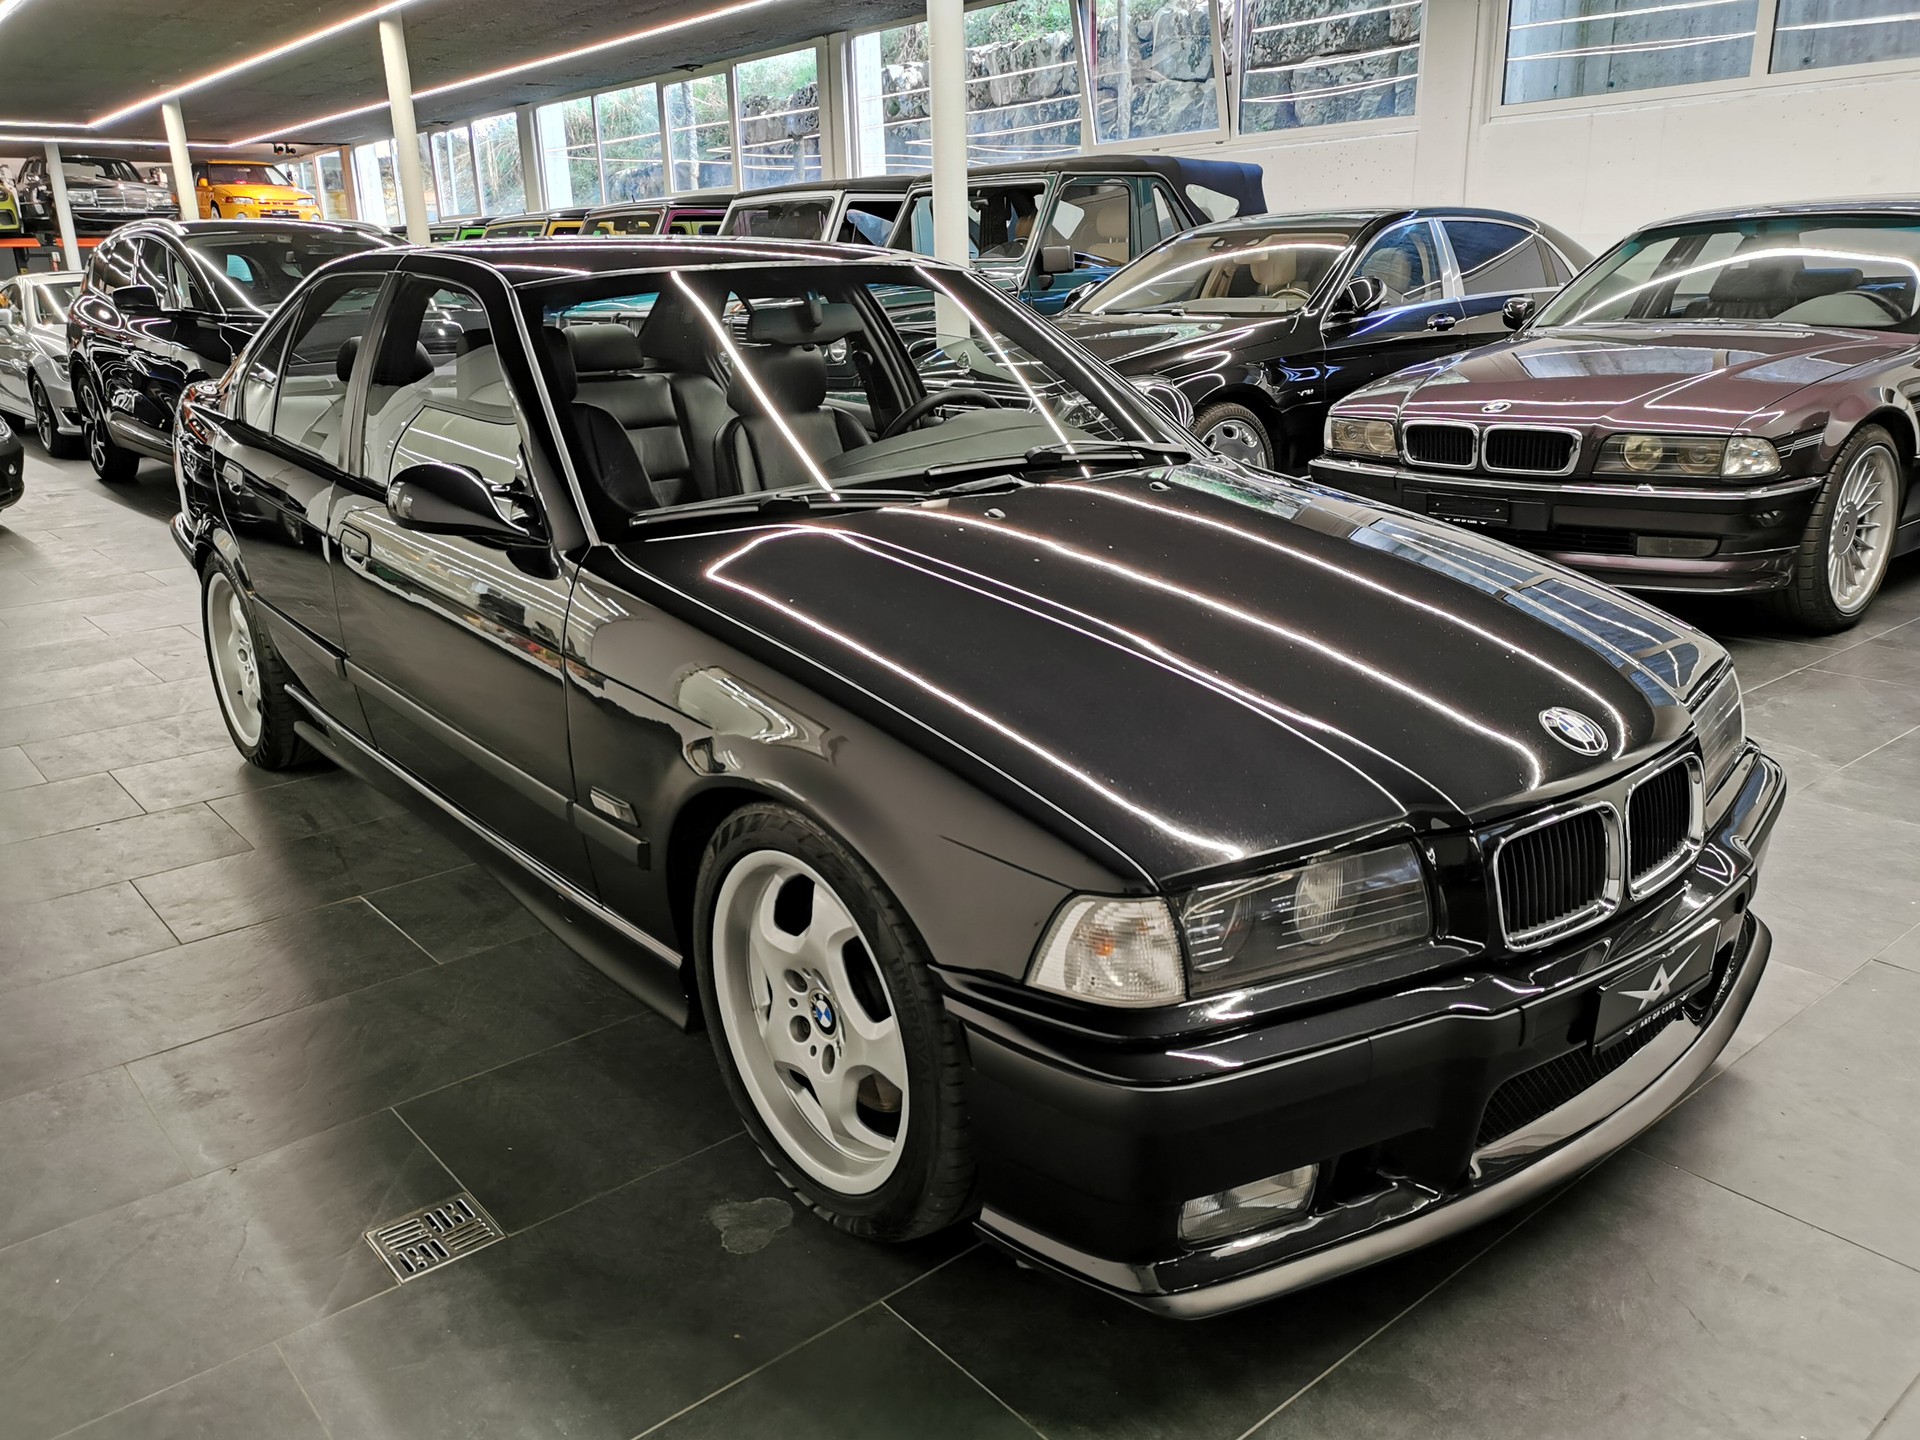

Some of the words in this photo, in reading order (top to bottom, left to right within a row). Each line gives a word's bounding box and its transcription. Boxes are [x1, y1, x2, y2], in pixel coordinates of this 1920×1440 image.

[1640, 1015, 1652, 1028] ART
[1652, 1010, 1660, 1020] OF
[1661, 1000, 1676, 1015] CARS
